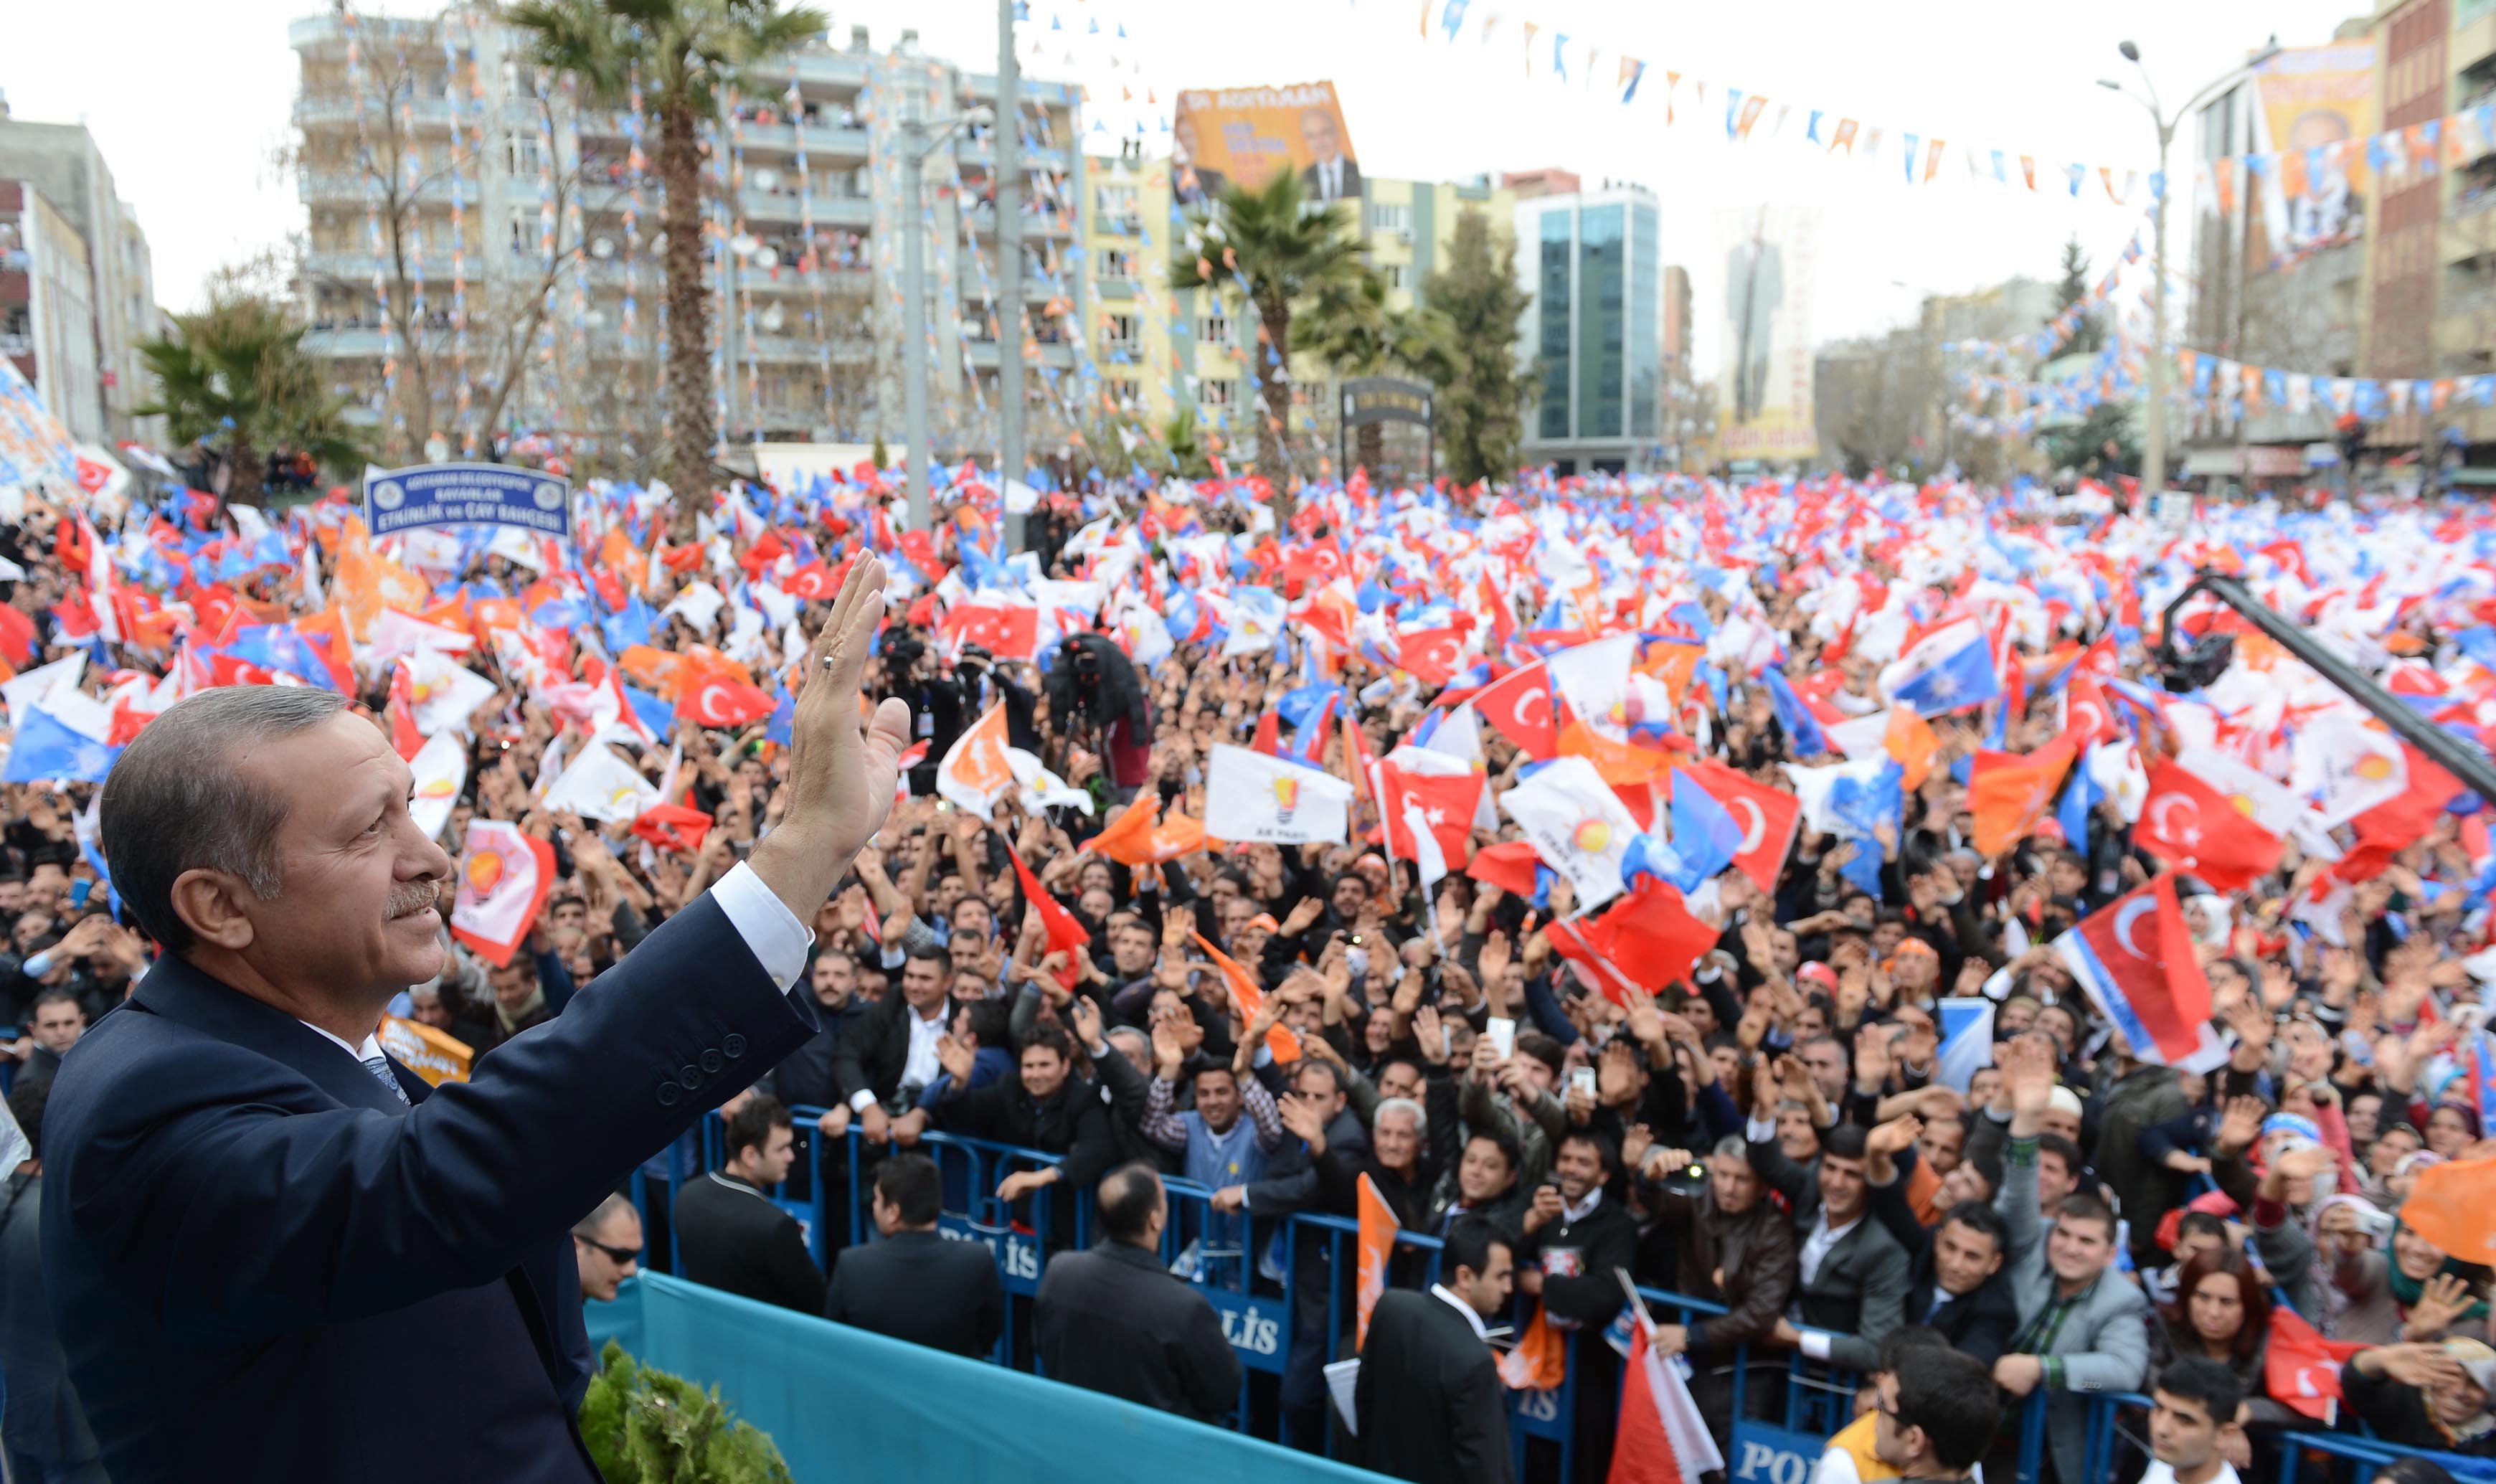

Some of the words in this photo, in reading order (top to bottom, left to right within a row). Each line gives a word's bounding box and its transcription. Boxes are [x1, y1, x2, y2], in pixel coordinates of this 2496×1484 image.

[435, 488, 503, 502] BAYANLAR
[378, 501, 444, 531] ETKİNLİK
[1221, 1305, 1279, 1355] LİS
